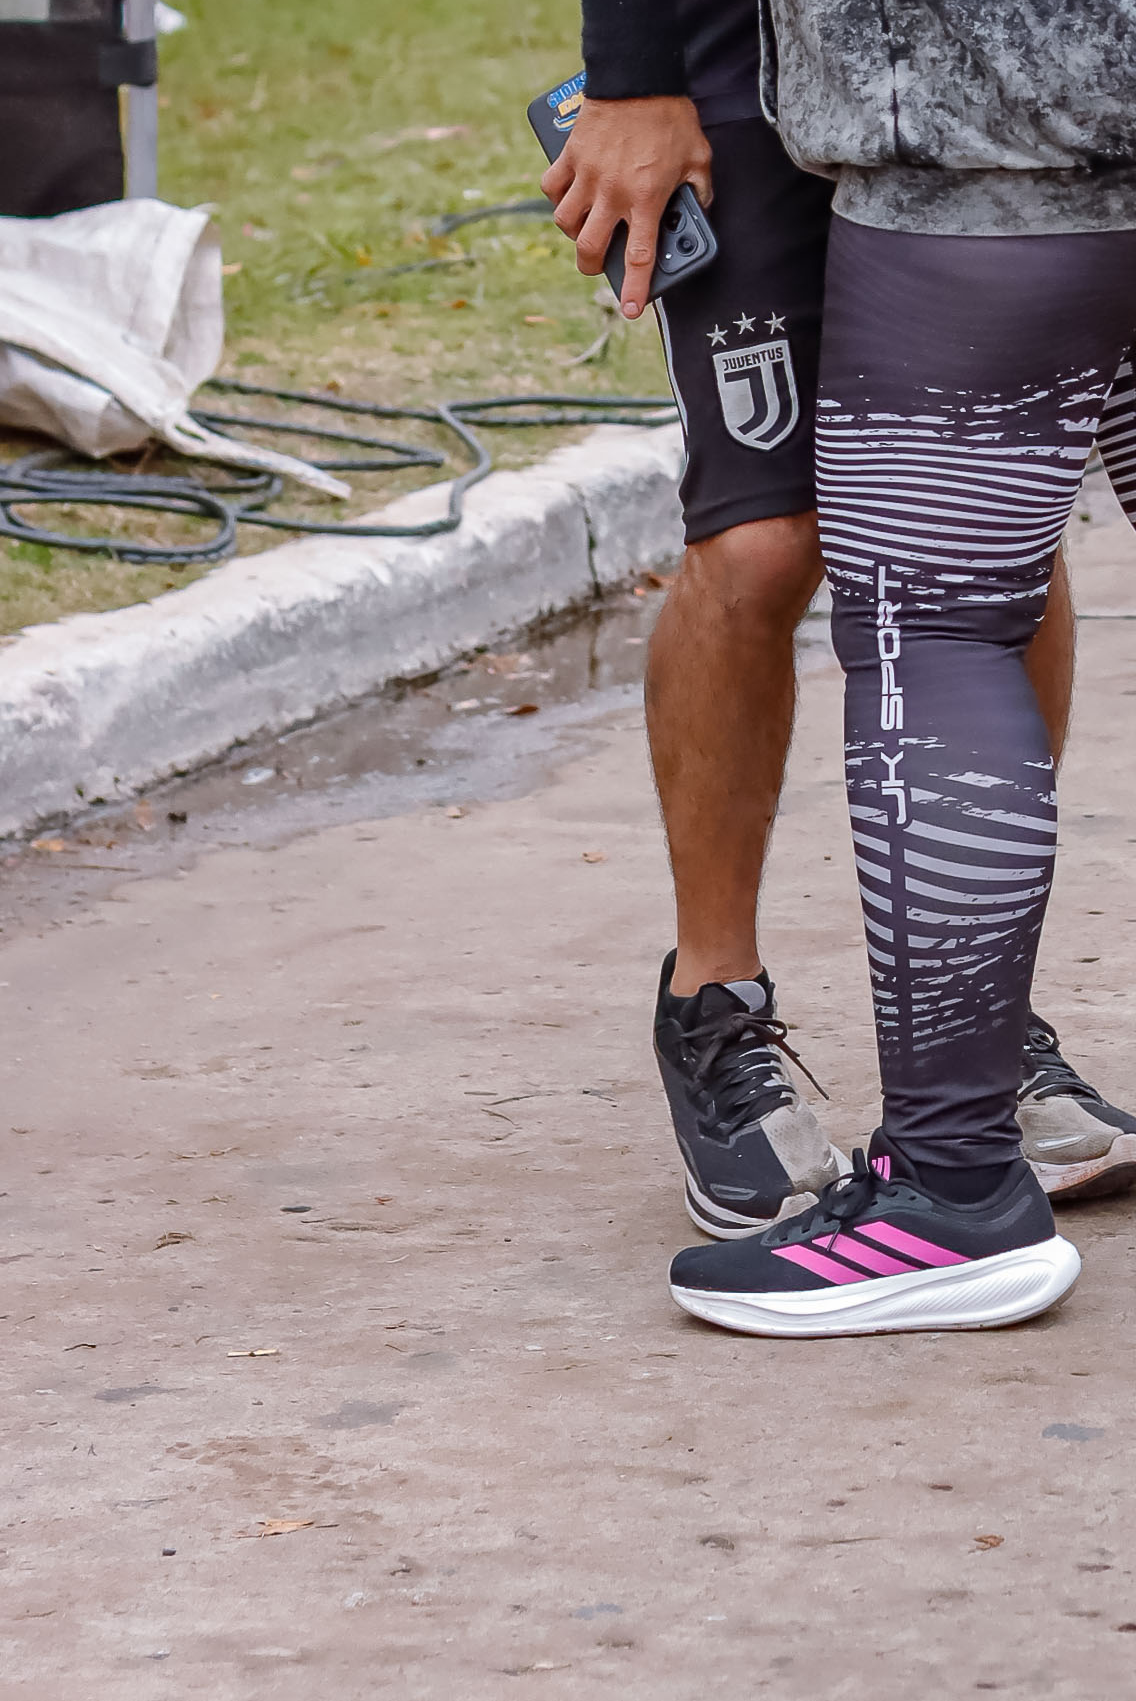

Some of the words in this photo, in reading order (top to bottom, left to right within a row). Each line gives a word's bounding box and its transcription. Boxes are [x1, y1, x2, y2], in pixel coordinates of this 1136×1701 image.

[722, 347, 784, 371] JUVENTUS
[876, 565, 904, 730] SPORT
[880, 750, 907, 825] JK
